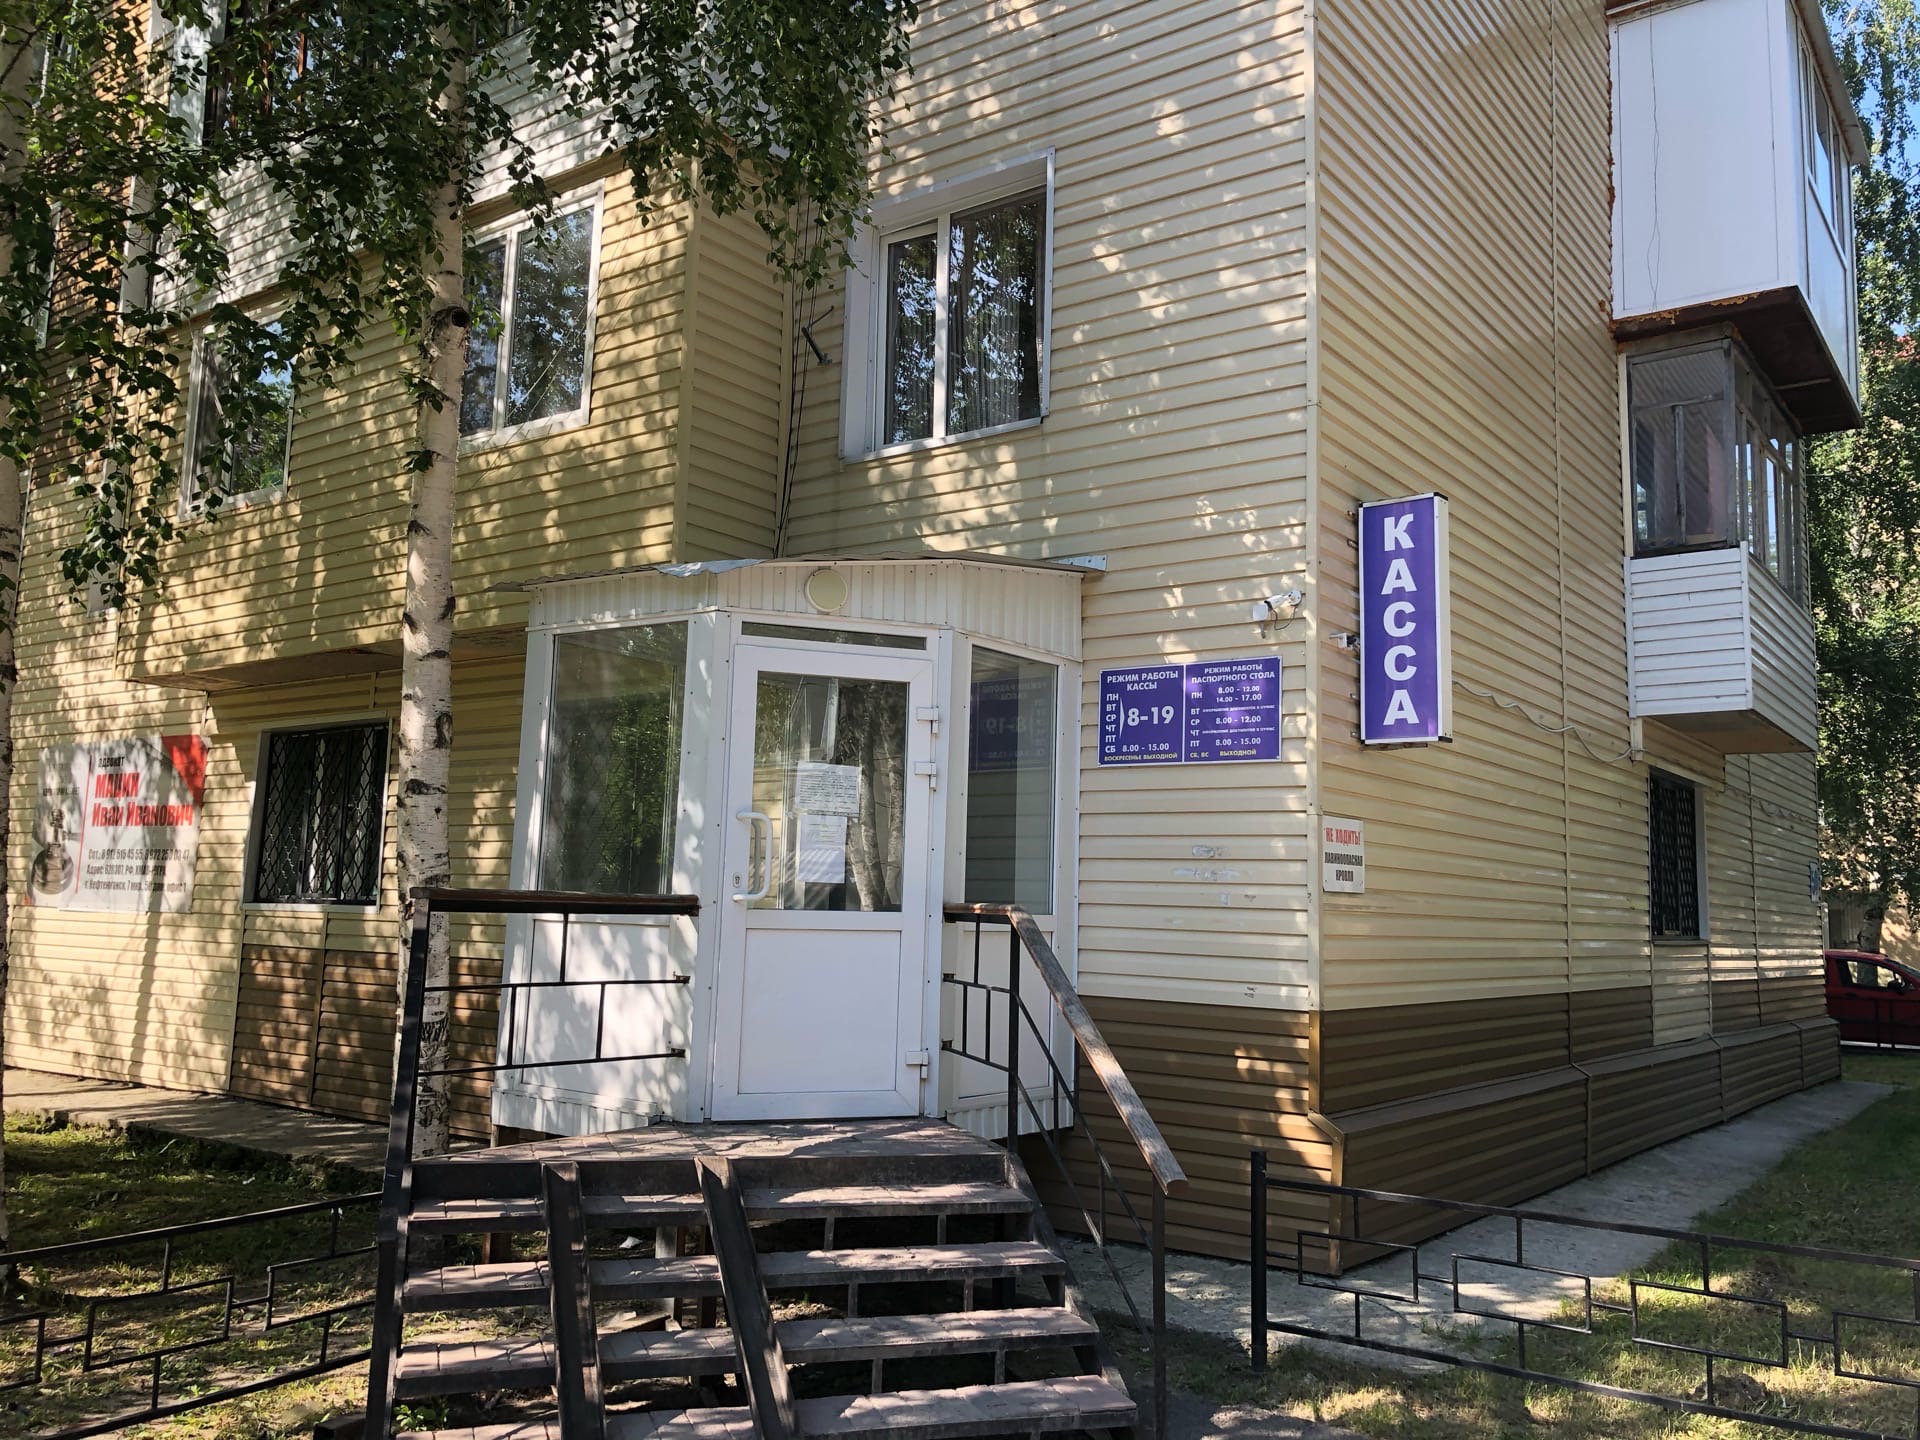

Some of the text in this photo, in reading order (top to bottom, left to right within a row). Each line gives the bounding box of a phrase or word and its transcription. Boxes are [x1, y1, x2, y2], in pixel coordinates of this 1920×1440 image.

[1381, 513, 1419, 726] КАССА
[1204, 666, 1230, 674] РЕЖИМ
[1107, 670, 1178, 683] РЕЖИМ РАБОТЫ
[1192, 673, 1247, 684] ПАСПОРТНОГО
[1127, 682, 1157, 691] КАССЫ
[1242, 694, 1262, 702] 17.00
[1128, 706, 1174, 726] 8-19
[1122, 744, 1139, 752] 8.00
[1148, 743, 1170, 751] 15.00
[1220, 748, 1256, 757] ВЫХОДНОЙ
[1144, 752, 1178, 760] ВЫХОДНОЙ
[92, 802, 194, 827] Иван Иванович
[1326, 827, 1334, 842] НЕ
